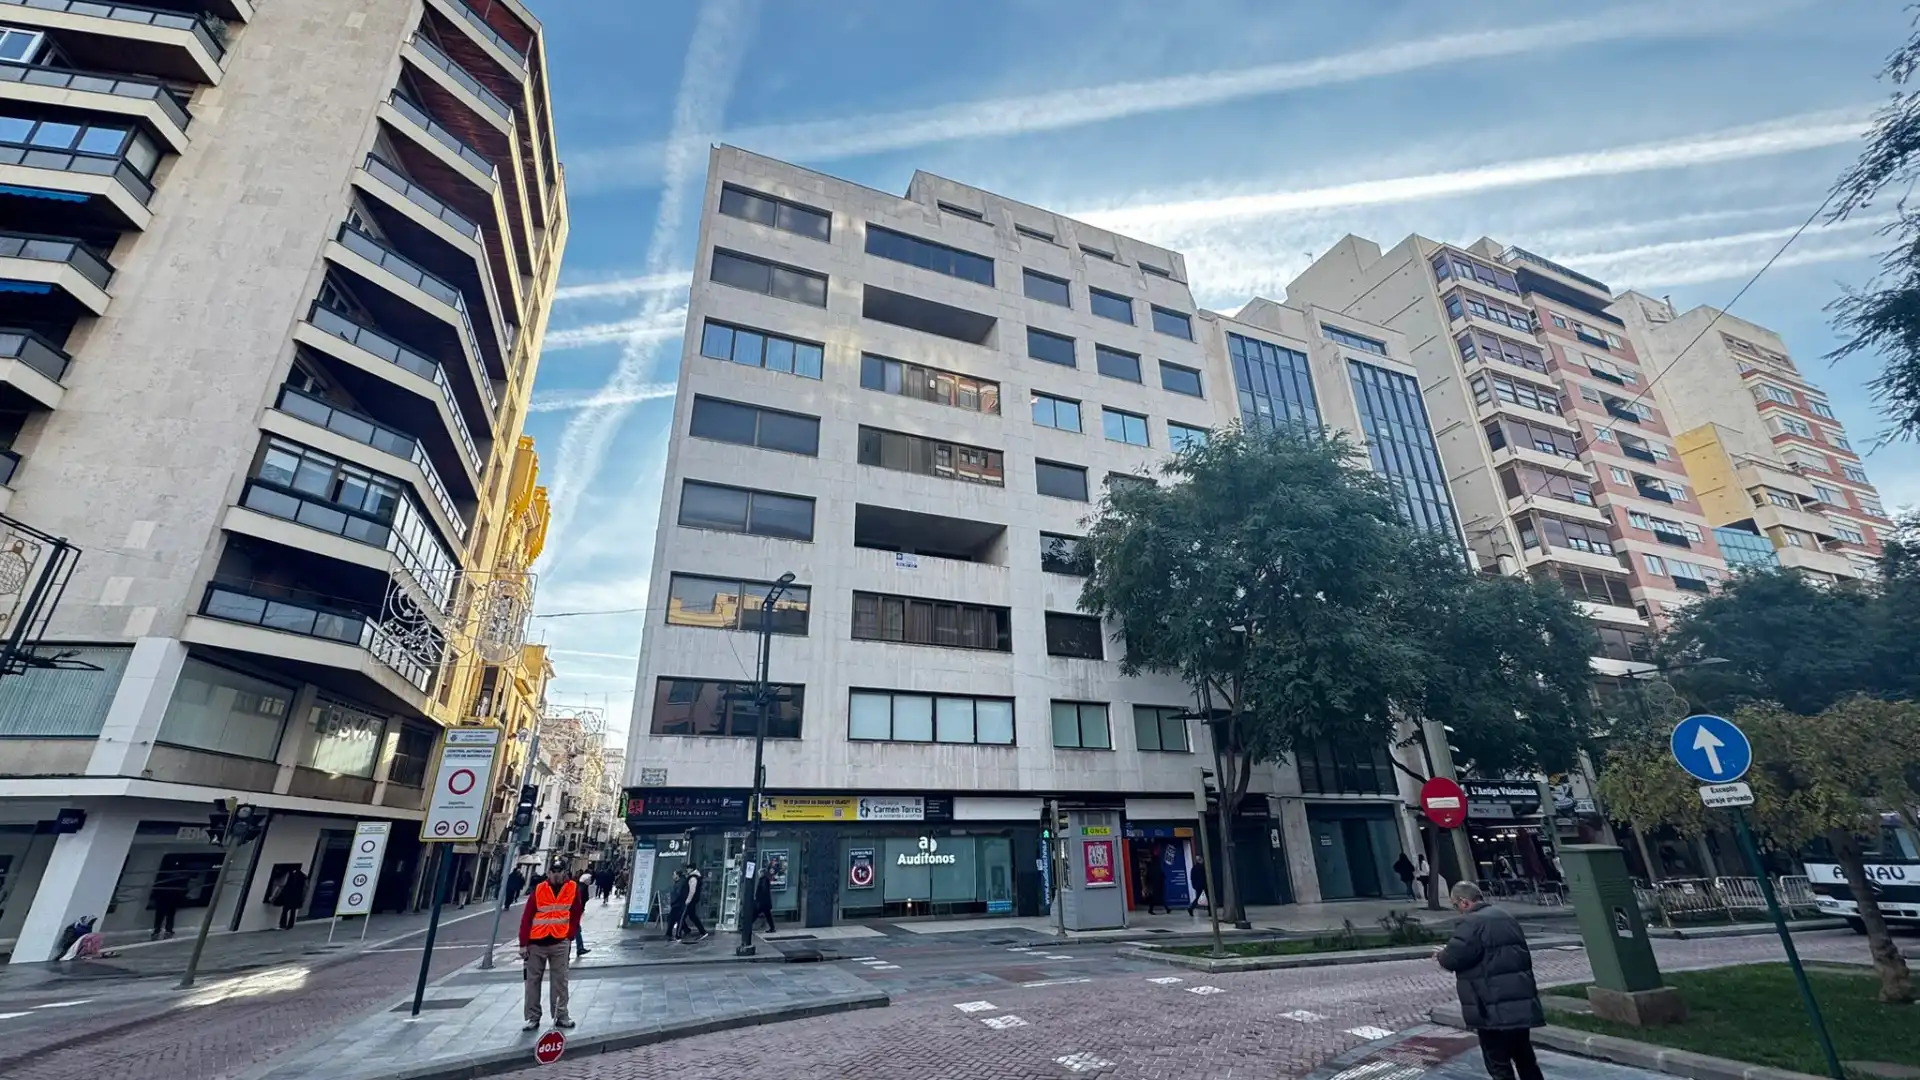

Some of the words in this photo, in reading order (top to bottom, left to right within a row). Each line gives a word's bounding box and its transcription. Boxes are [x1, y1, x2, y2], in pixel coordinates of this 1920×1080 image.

[1470, 787, 1500, 797] L'Antiga
[1500, 787, 1538, 796] Valenciana
[1705, 797, 1726, 805] garaje
[1726, 794, 1752, 802] privado
[897, 852, 956, 865] Audífonos
[1833, 866, 1905, 880] ANAU
[538, 1041, 562, 1054] STOP
